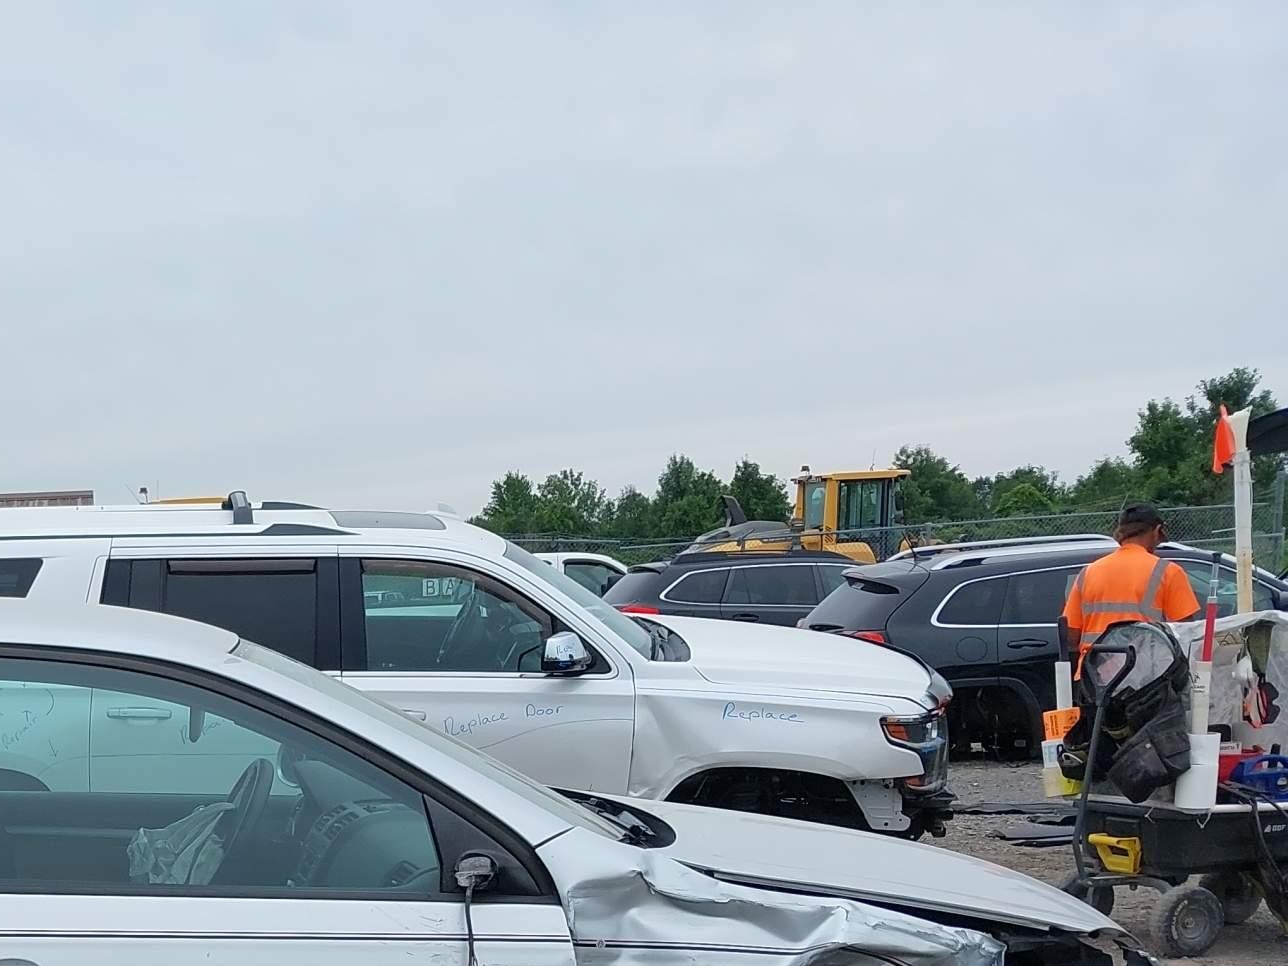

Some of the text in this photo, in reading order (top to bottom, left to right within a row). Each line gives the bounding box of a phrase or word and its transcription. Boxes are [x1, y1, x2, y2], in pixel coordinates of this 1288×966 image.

[443, 703, 565, 736] Replace Door
[722, 701, 806, 723] Replace
